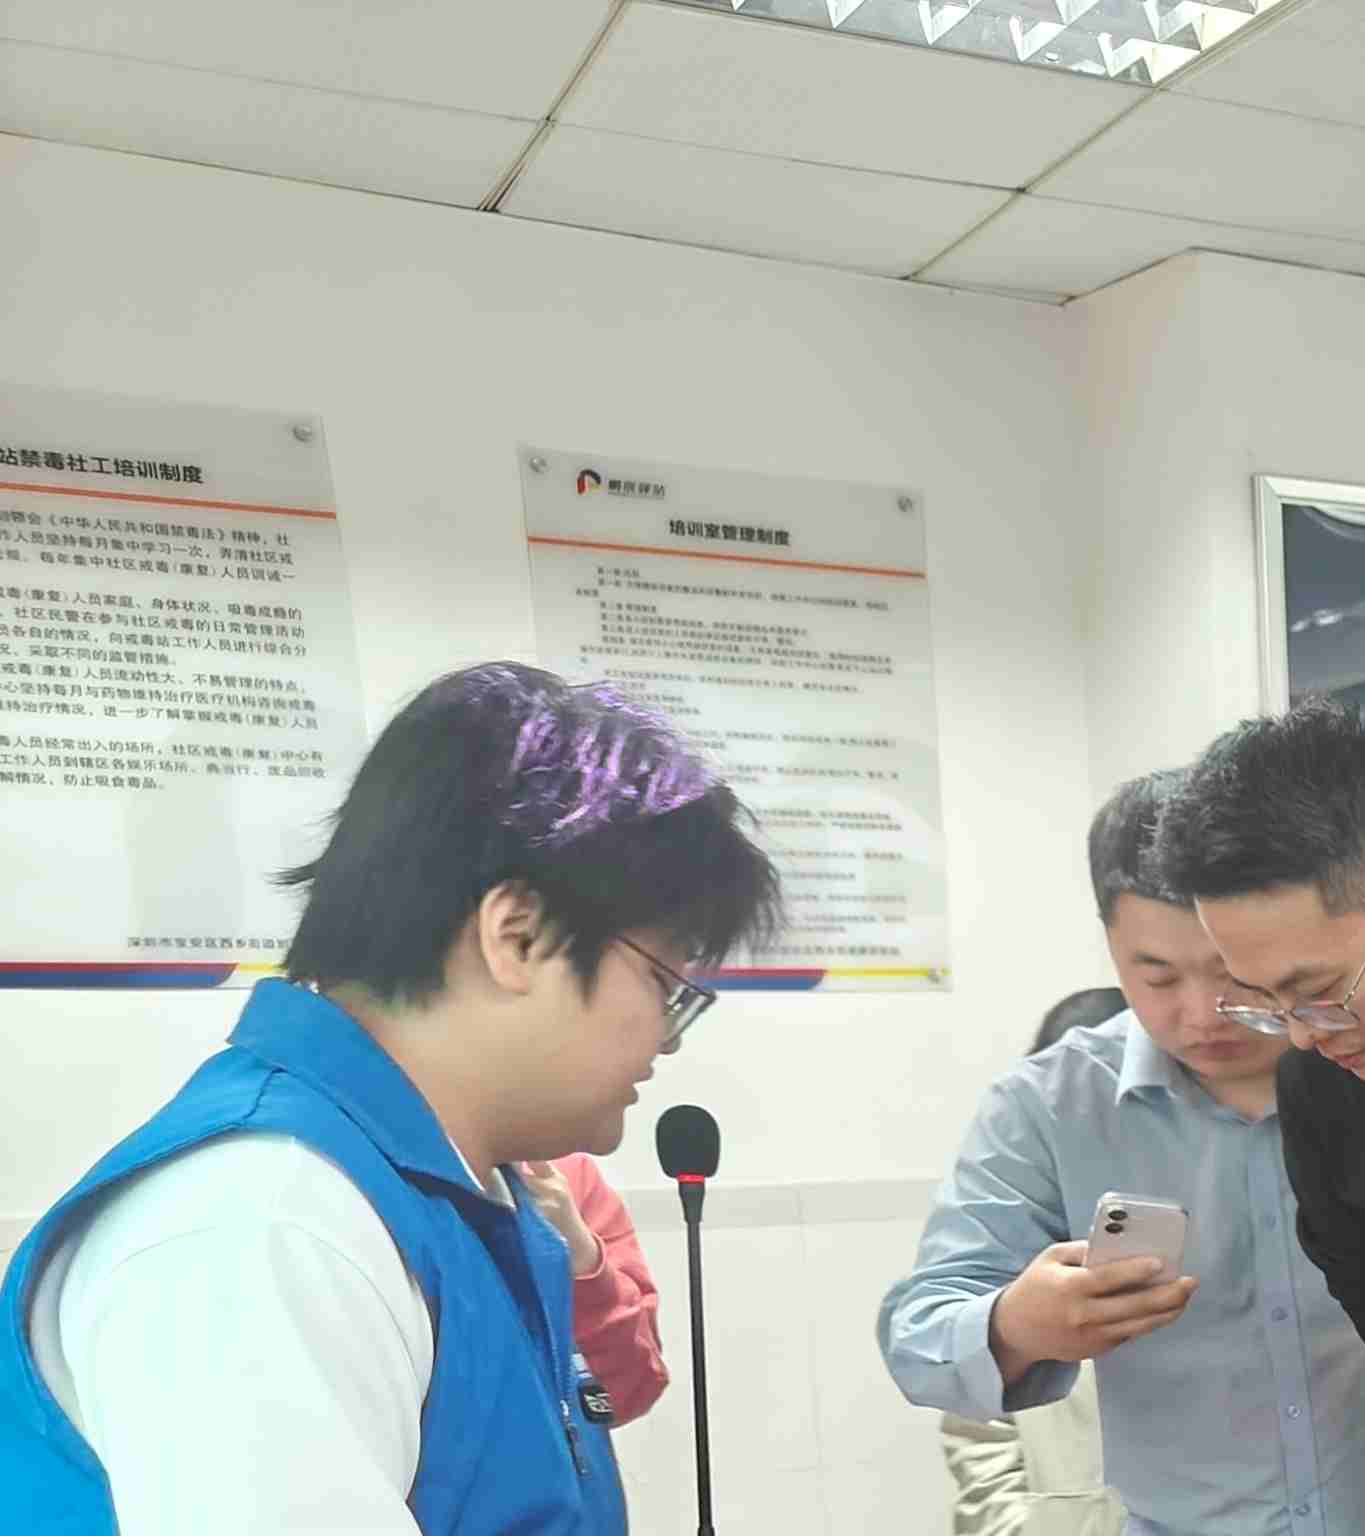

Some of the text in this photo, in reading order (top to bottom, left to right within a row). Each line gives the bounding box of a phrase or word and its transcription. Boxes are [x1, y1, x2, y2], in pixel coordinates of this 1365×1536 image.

[0, 448, 203, 484] 站禁毒社工培训制度
[669, 519, 790, 546] 培训室管理制度
